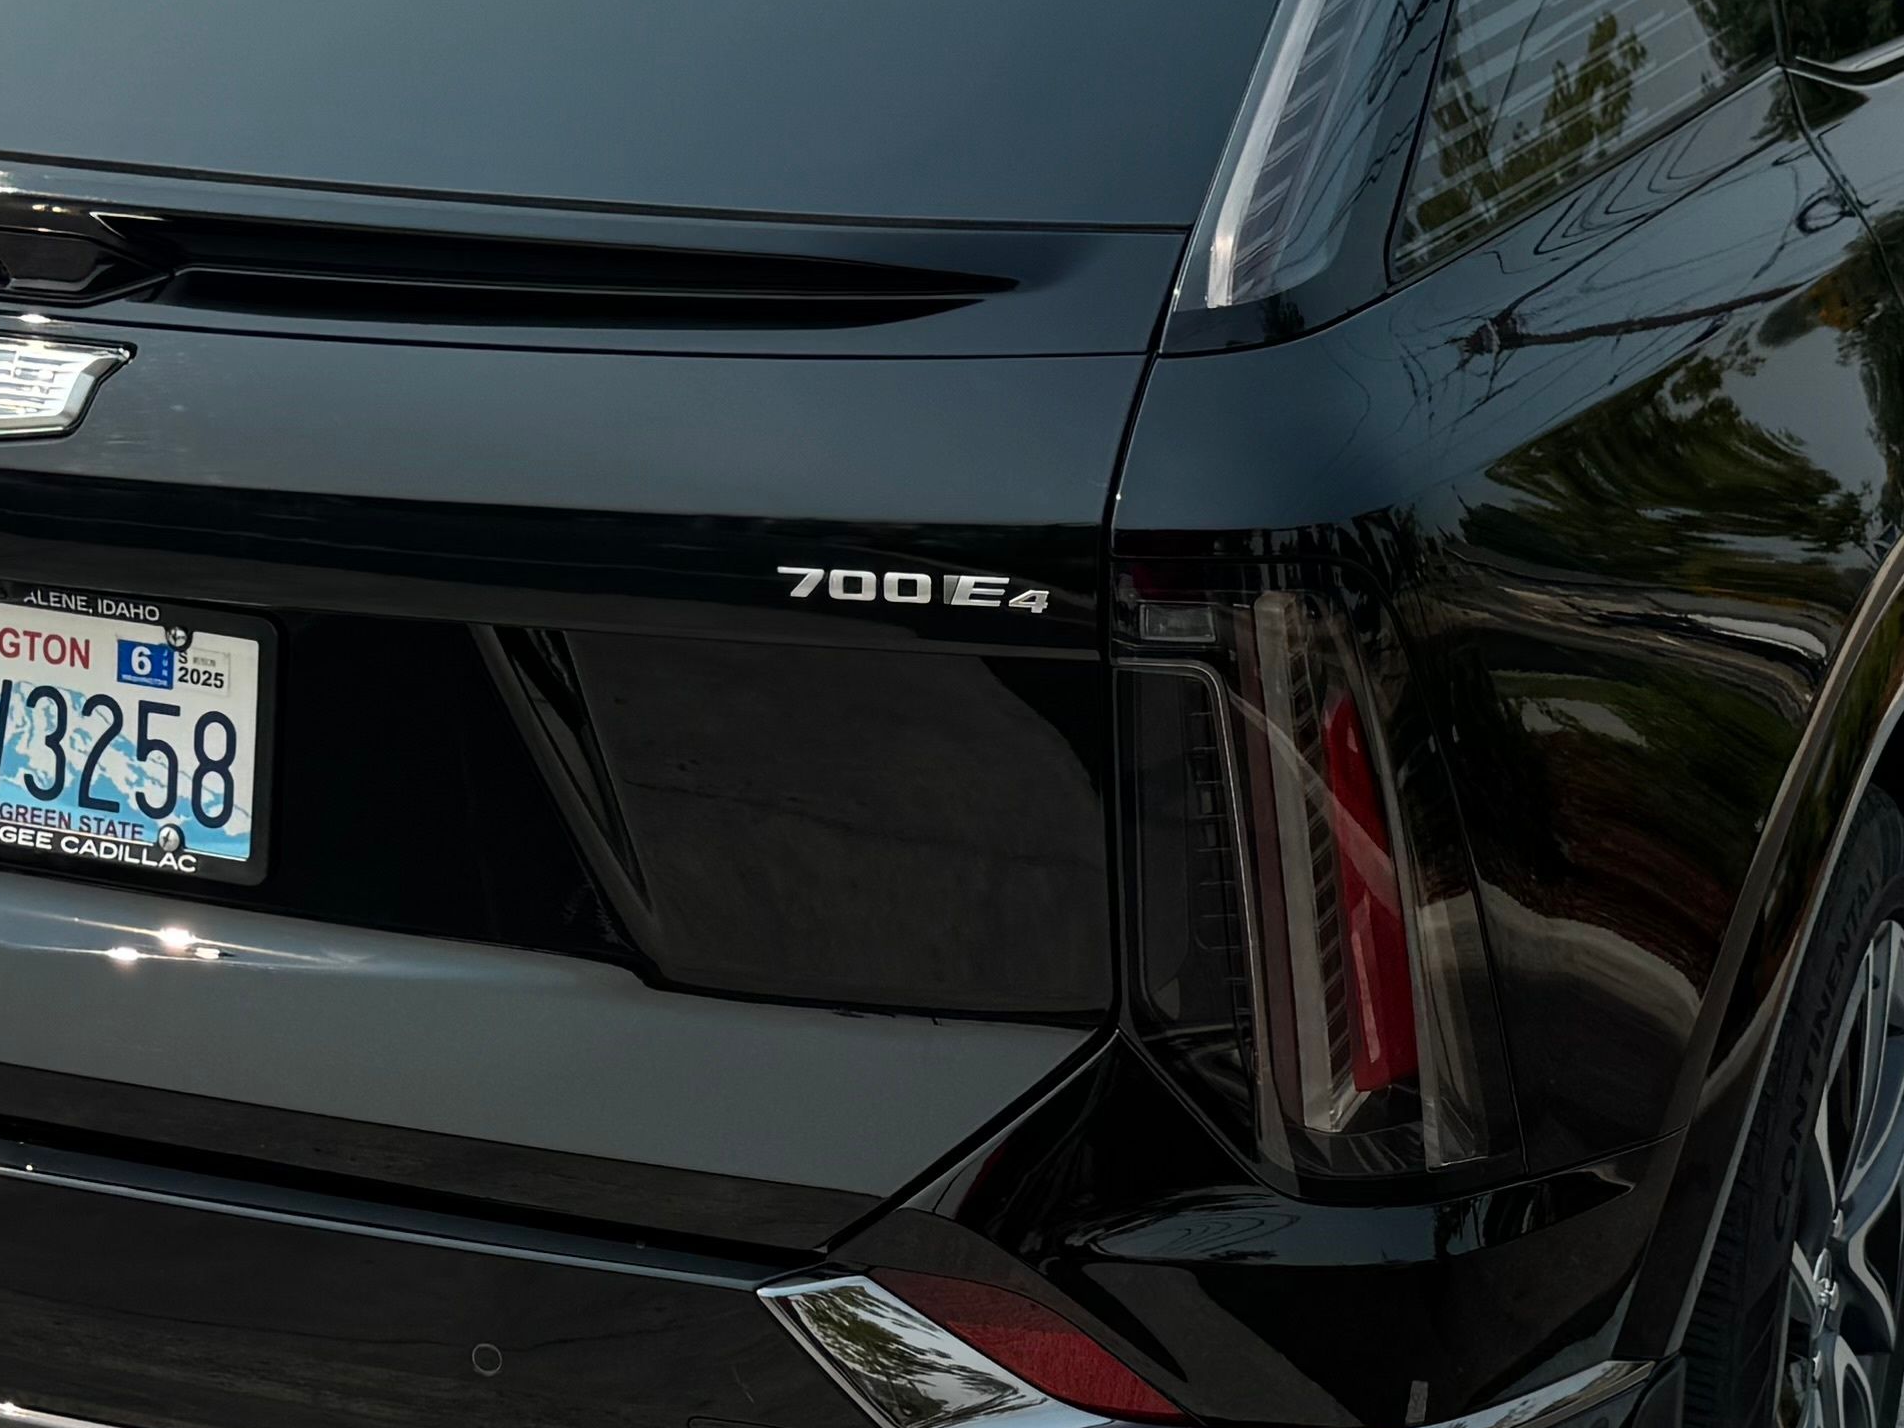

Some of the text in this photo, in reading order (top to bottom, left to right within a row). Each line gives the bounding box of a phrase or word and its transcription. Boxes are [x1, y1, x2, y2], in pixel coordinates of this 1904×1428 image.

[97, 598, 161, 622] IDAHO
[131, 645, 152, 676] 6
[178, 666, 225, 690] 2025
[78, 814, 145, 842] STATE
[60, 835, 197, 873] CADILLAC
[1773, 865, 1878, 1245] CONTINENTAL
